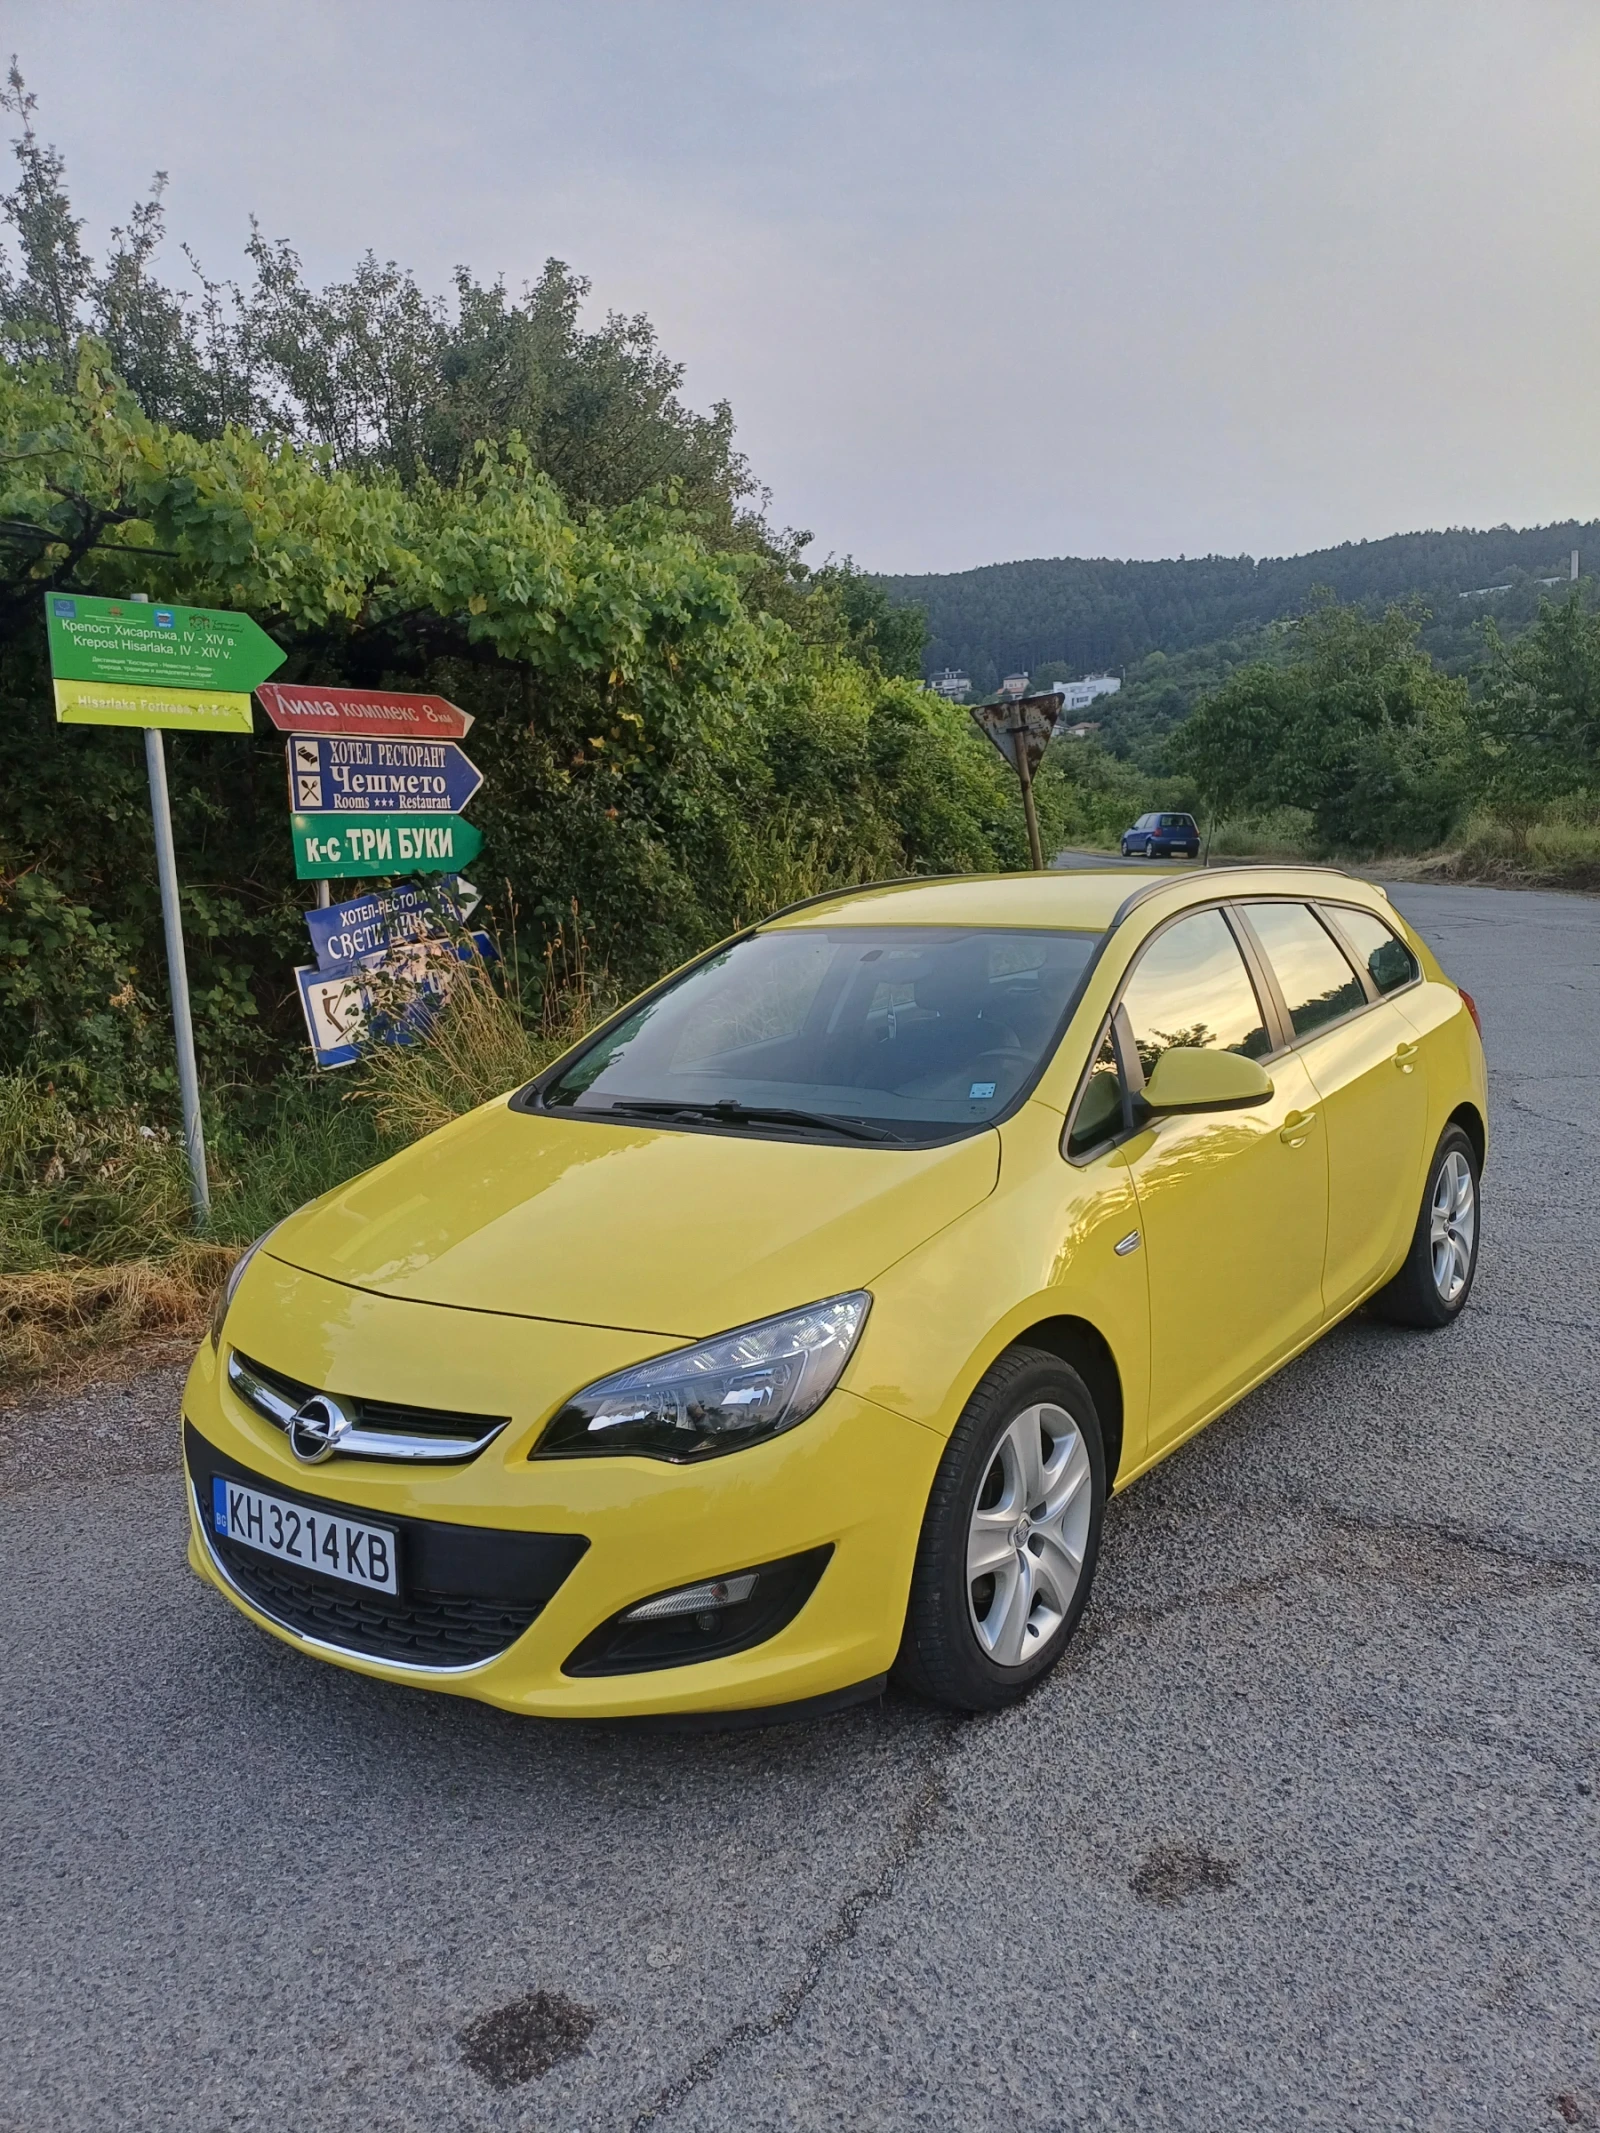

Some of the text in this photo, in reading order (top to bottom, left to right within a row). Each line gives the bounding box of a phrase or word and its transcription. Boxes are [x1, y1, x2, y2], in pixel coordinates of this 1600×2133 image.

[62, 619, 111, 634] Крепост
[114, 624, 181, 642] Хисарлъка,
[183, 631, 195, 642] IV
[205, 633, 224, 645] XIV
[227, 638, 237, 647] в.
[73, 635, 119, 650] Krepost
[122, 639, 177, 656] Hisarlaka,
[180, 645, 191, 656] IV
[201, 647, 220, 658] XIV
[223, 651, 232, 660] v.
[78, 695, 137, 711] Hisarlaka
[276, 694, 339, 717] Лима
[339, 702, 420, 722] комплекс
[329, 741, 446, 768] ХОТЕЛ РЕСТОРАНТ
[329, 765, 446, 794] Чешмето
[333, 793, 452, 809] Rooms Restaurant
[346, 828, 393, 861] ТРИ
[397, 827, 454, 859] БУКИ
[327, 922, 385, 960] СВЕТИ
[216, 1512, 227, 1528] BG
